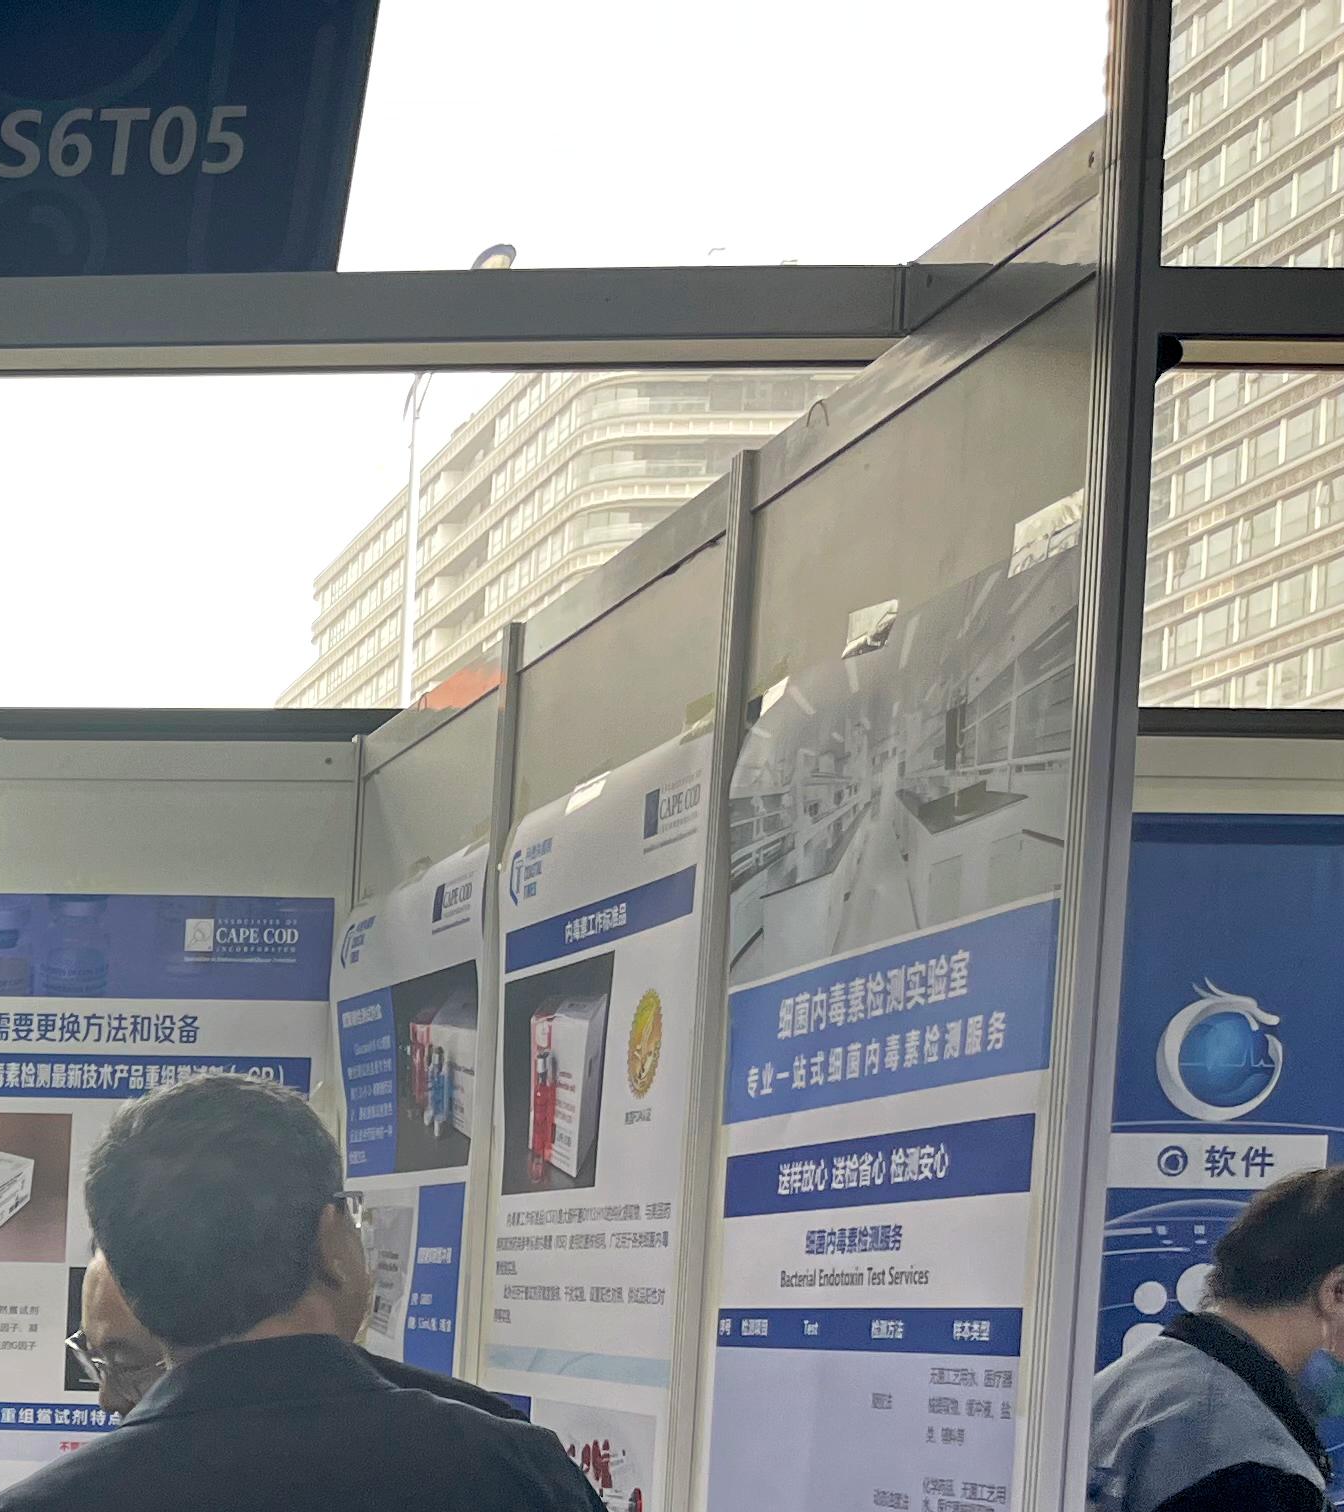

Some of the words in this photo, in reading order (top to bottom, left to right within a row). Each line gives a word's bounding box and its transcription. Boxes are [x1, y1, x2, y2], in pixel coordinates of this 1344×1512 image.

[215, 928, 260, 944] CAPE
[263, 928, 299, 945] COD
[777, 948, 971, 1041] 细菌内毒素检测实验室
[746, 1011, 1008, 1099] 专业一站式细菌内毒素检测服务
[776, 1151, 828, 1196] 送样放心
[830, 1148, 886, 1191] 送检省心
[890, 1143, 949, 1185] 检测安心
[1203, 1144, 1275, 1179] 软件
[805, 1223, 903, 1256] 细菌内毒素检测服务
[780, 1268, 816, 1288] Bacterial
[818, 1268, 864, 1288] Endotoxin
[866, 1267, 885, 1286] Test
[888, 1266, 929, 1286] Services
[803, 1319, 819, 1335] Test
